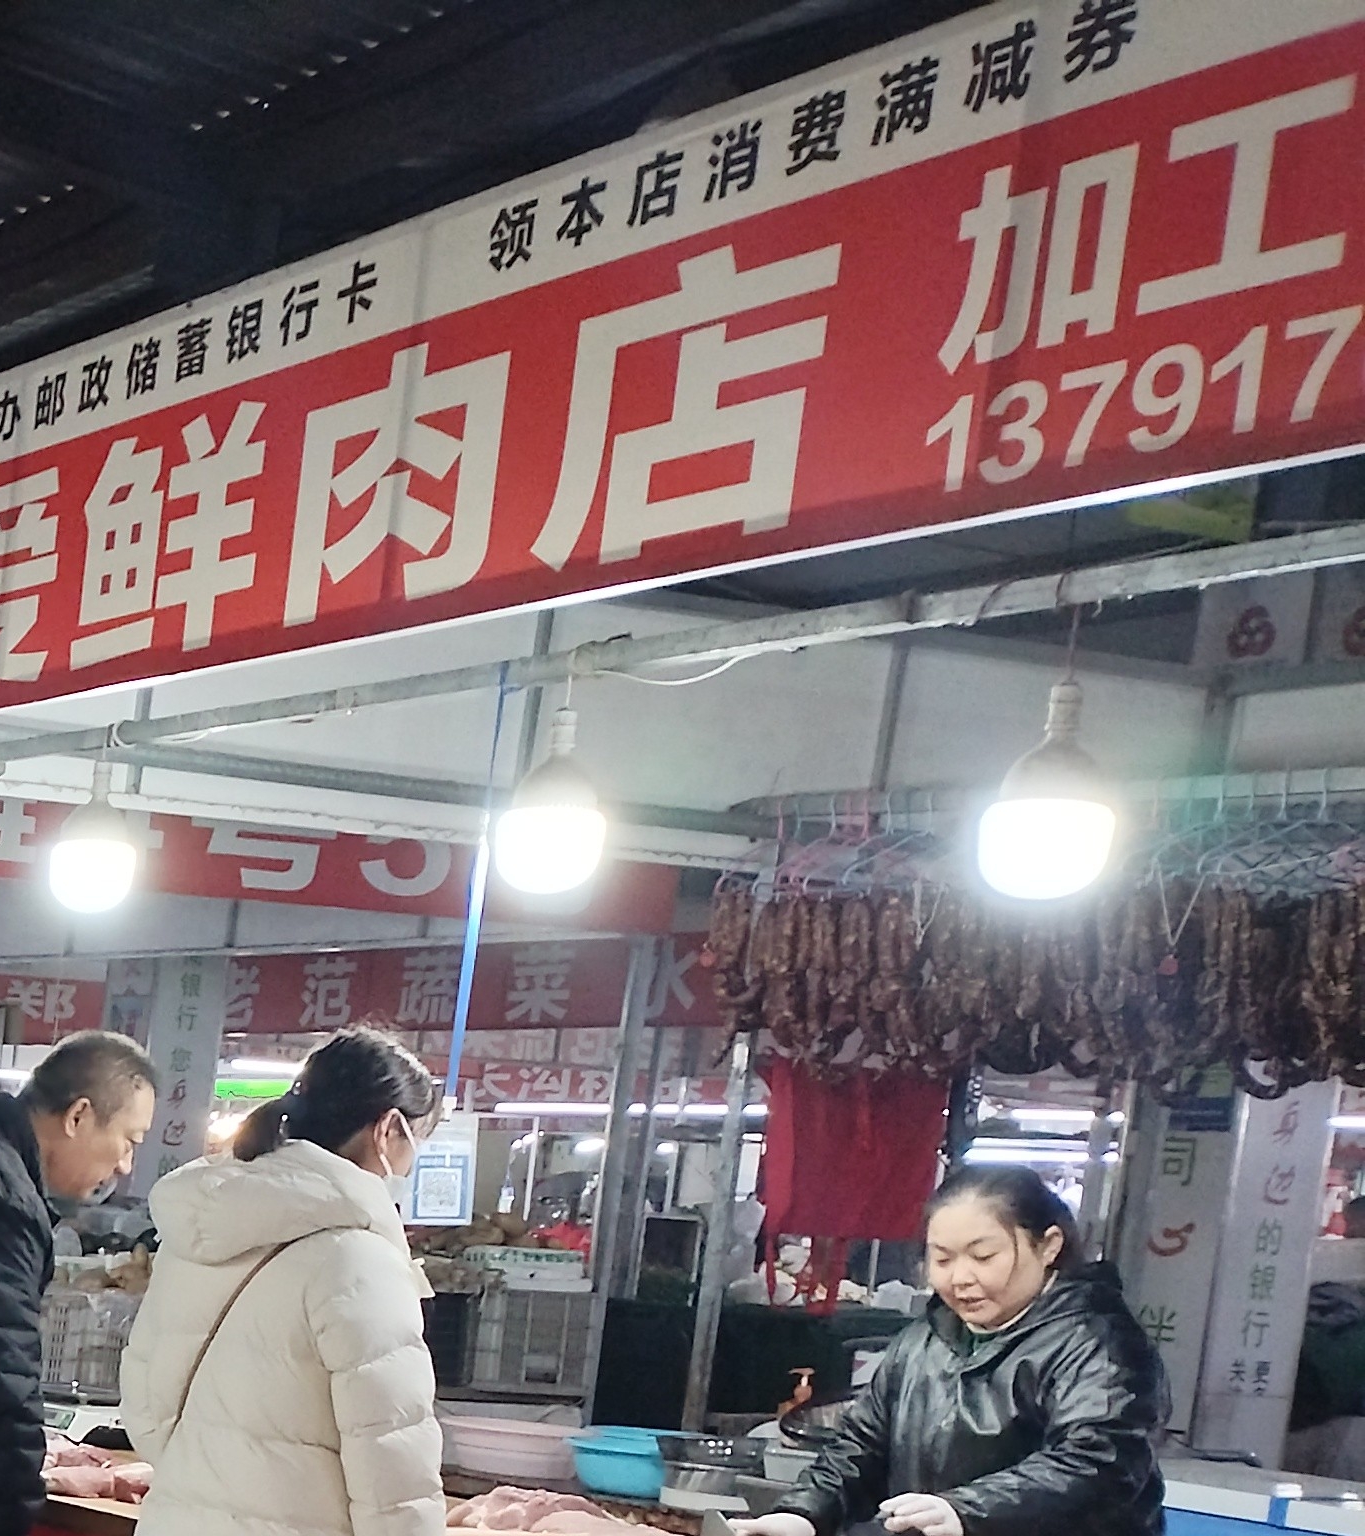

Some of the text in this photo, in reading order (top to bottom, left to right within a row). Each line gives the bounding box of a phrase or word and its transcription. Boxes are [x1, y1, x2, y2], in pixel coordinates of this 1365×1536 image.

[489, 0, 1137, 272] 领本店消费满减券
[939, 73, 1357, 375] 加工
[923, 304, 1363, 493] 137917
[6, 978, 76, 1026] 郑
